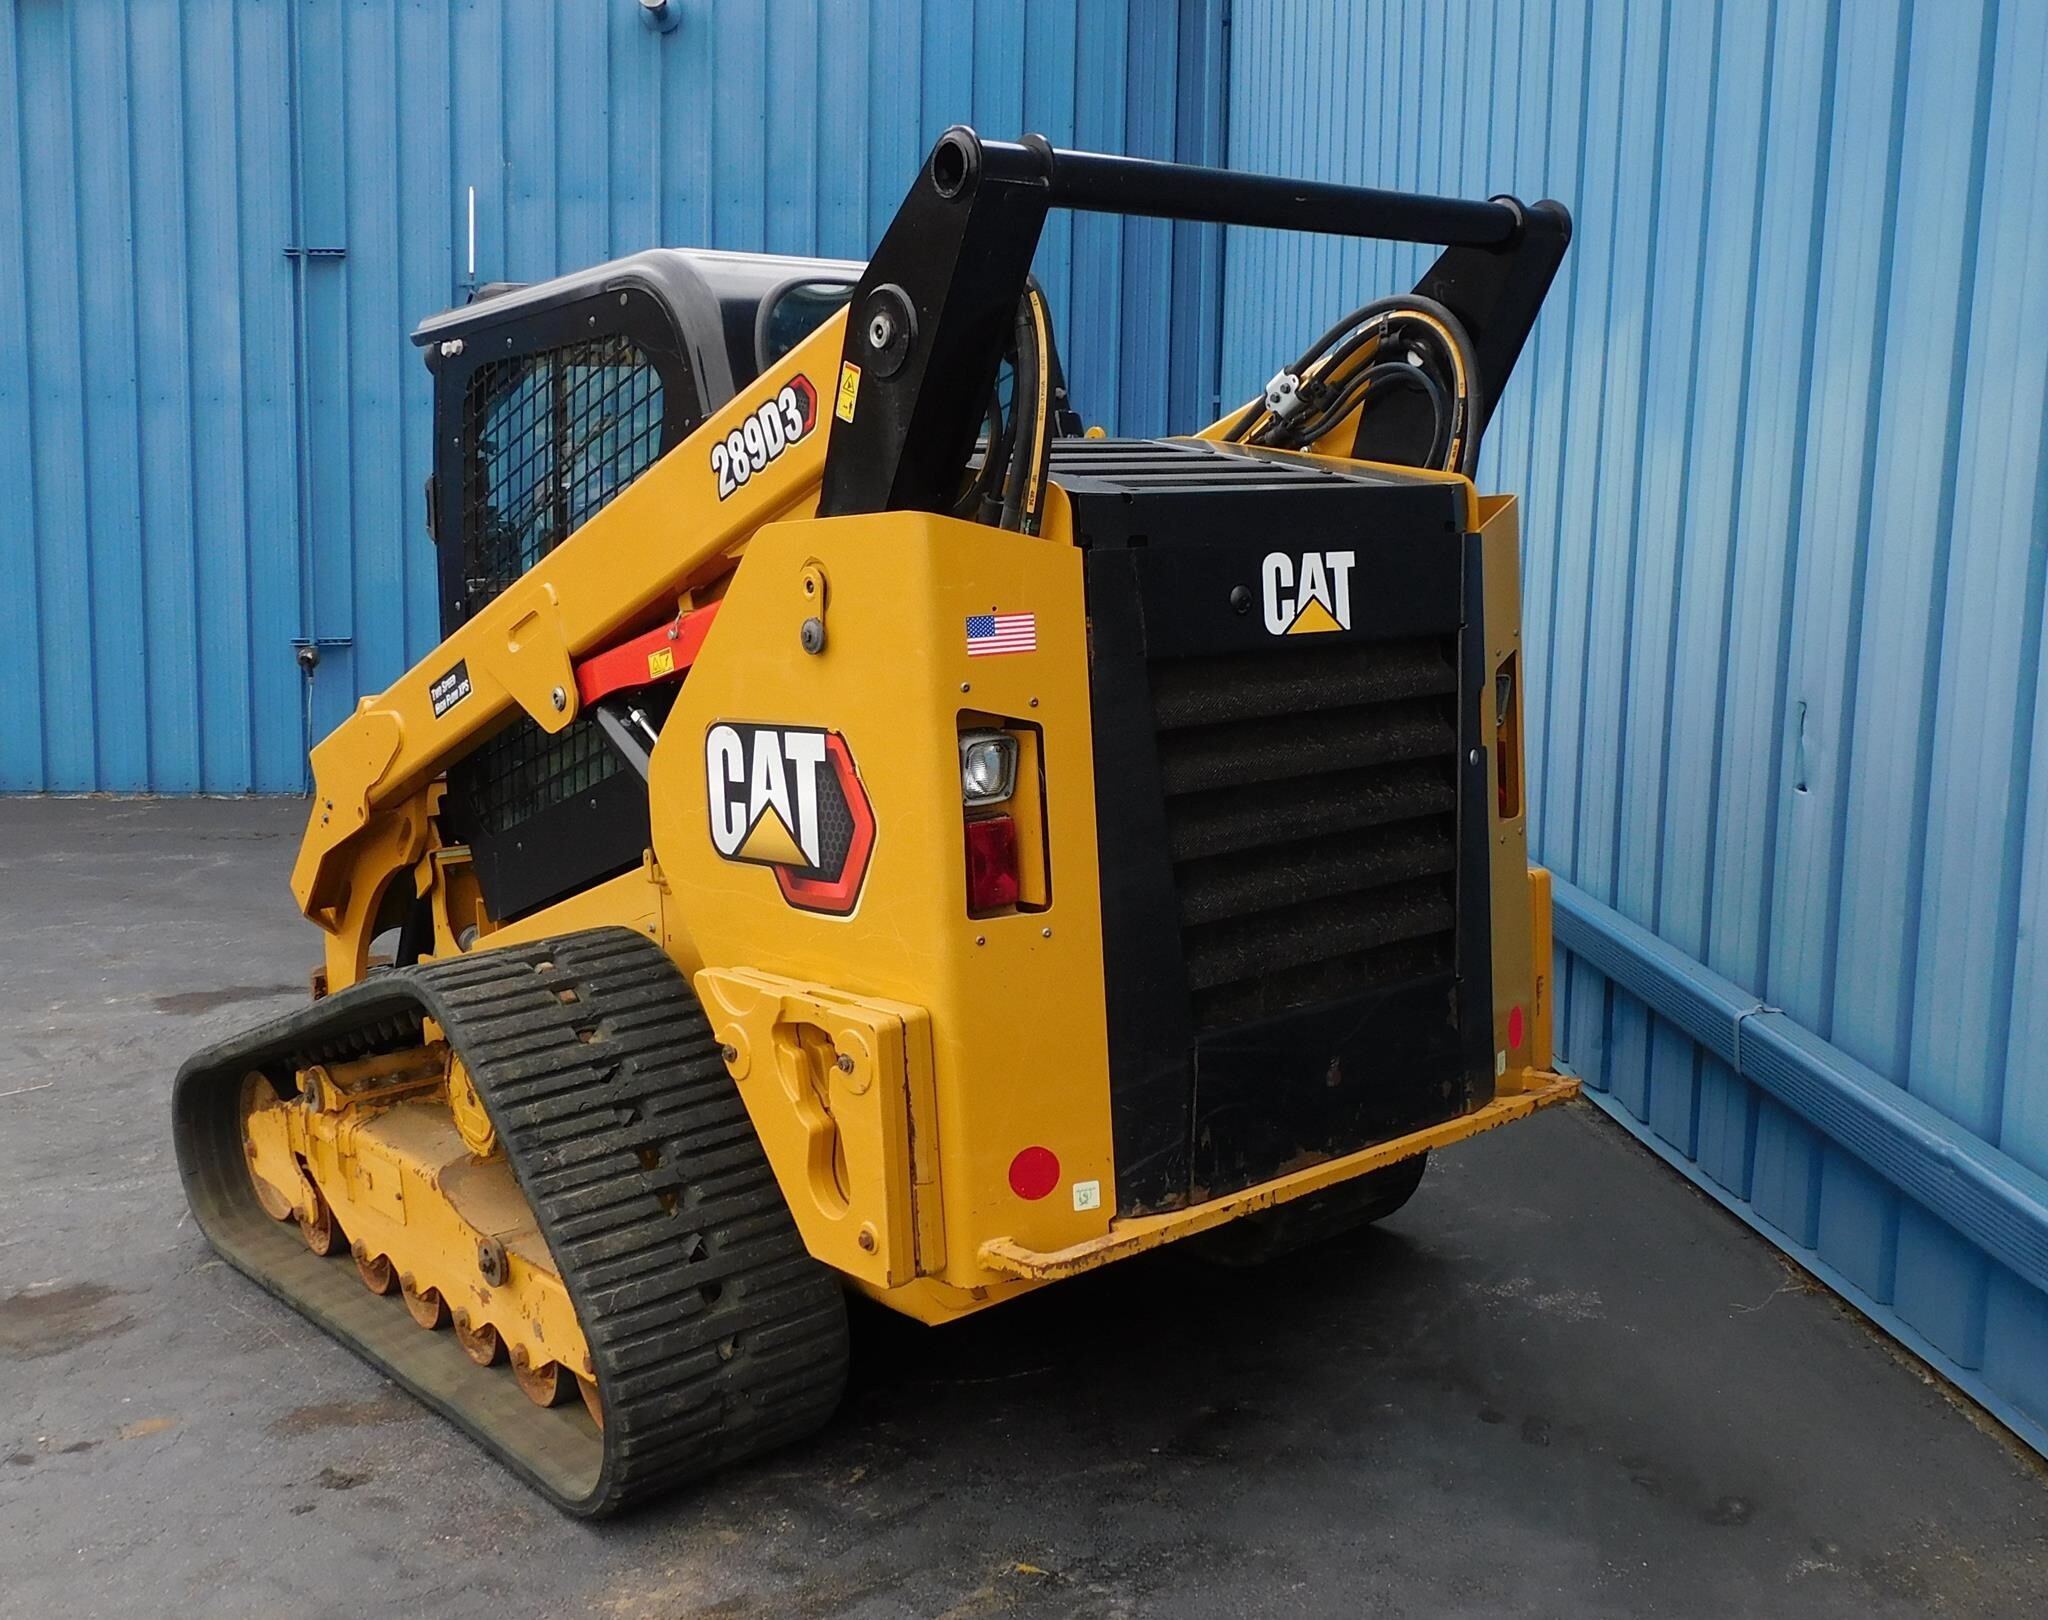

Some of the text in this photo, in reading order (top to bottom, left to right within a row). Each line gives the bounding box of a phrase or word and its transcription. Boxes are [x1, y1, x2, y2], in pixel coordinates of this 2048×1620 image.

[711, 386, 803, 499] 289D3
[1262, 550, 1356, 636] CAT
[706, 725, 826, 868] CAT
